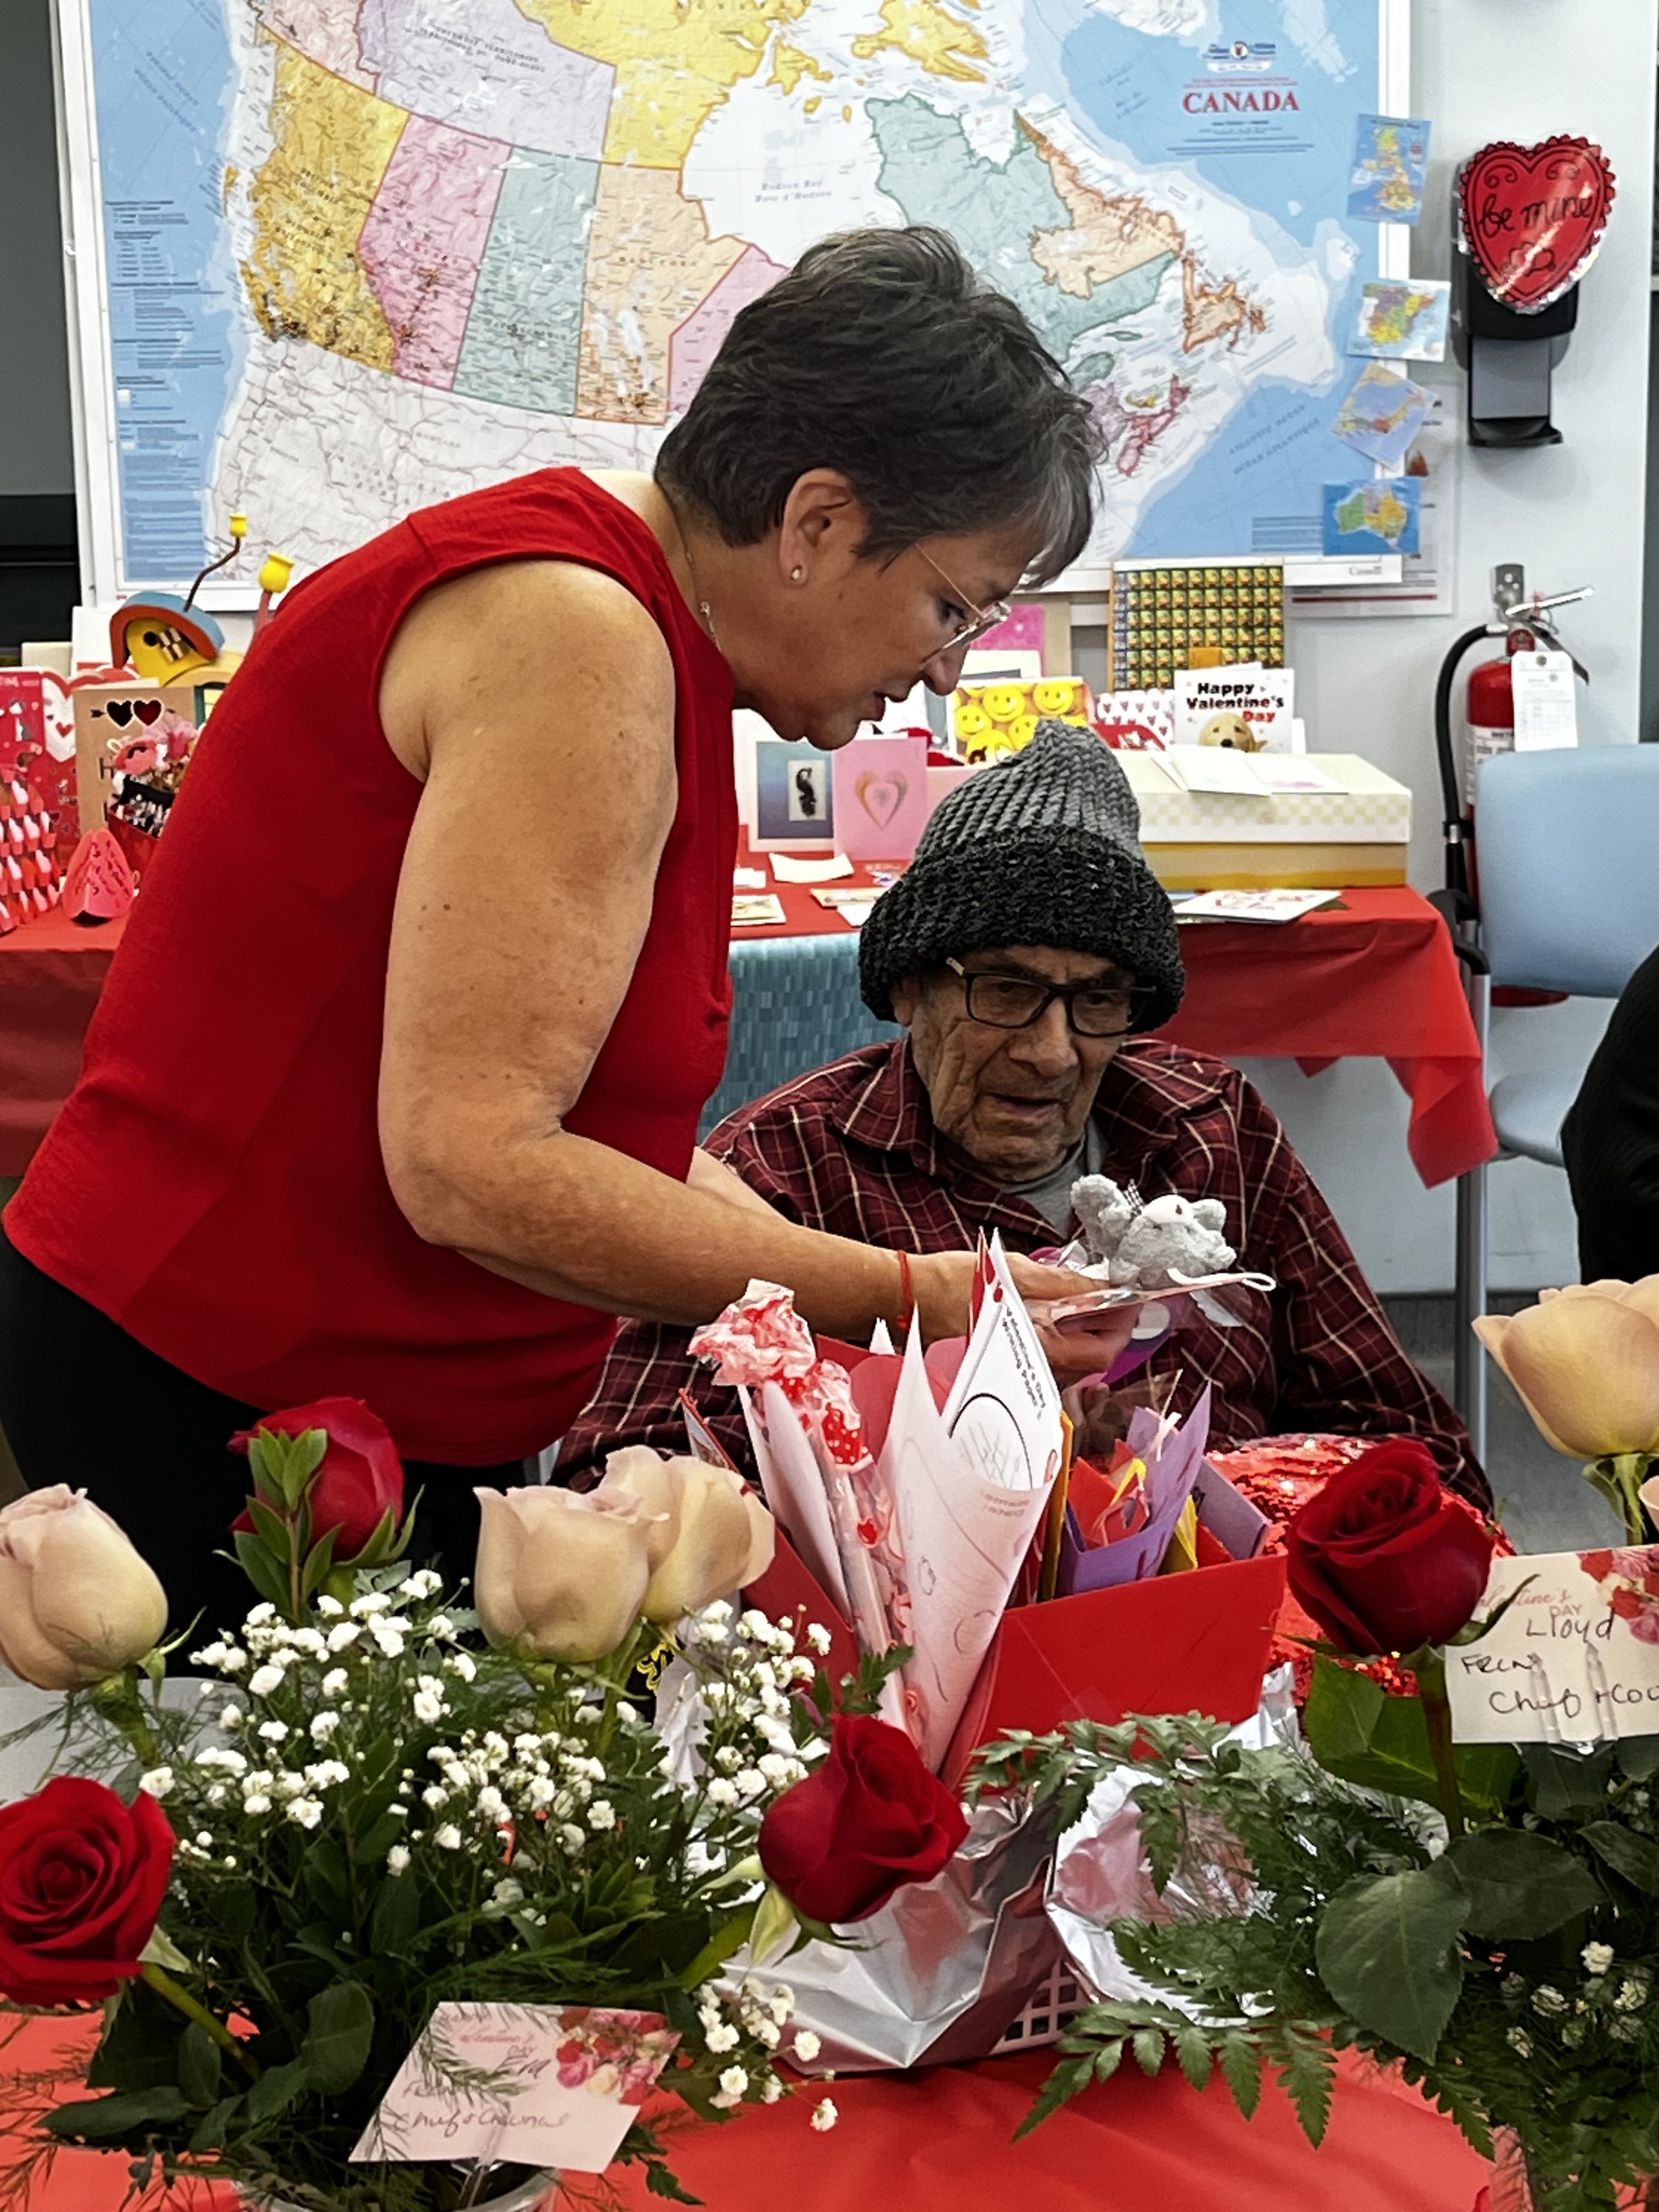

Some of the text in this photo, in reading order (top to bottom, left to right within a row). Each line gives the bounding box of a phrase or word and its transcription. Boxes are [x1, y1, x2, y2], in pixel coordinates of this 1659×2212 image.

[1183, 90, 1300, 114] CANADA
[1480, 193, 1593, 239] be mine
[1198, 682, 1255, 697] Happy
[1186, 696, 1284, 710] Valentine's
[1243, 710, 1276, 723] Day
[1549, 1604, 1582, 1615] DAY
[1526, 1606, 1616, 1644] Lloyd
